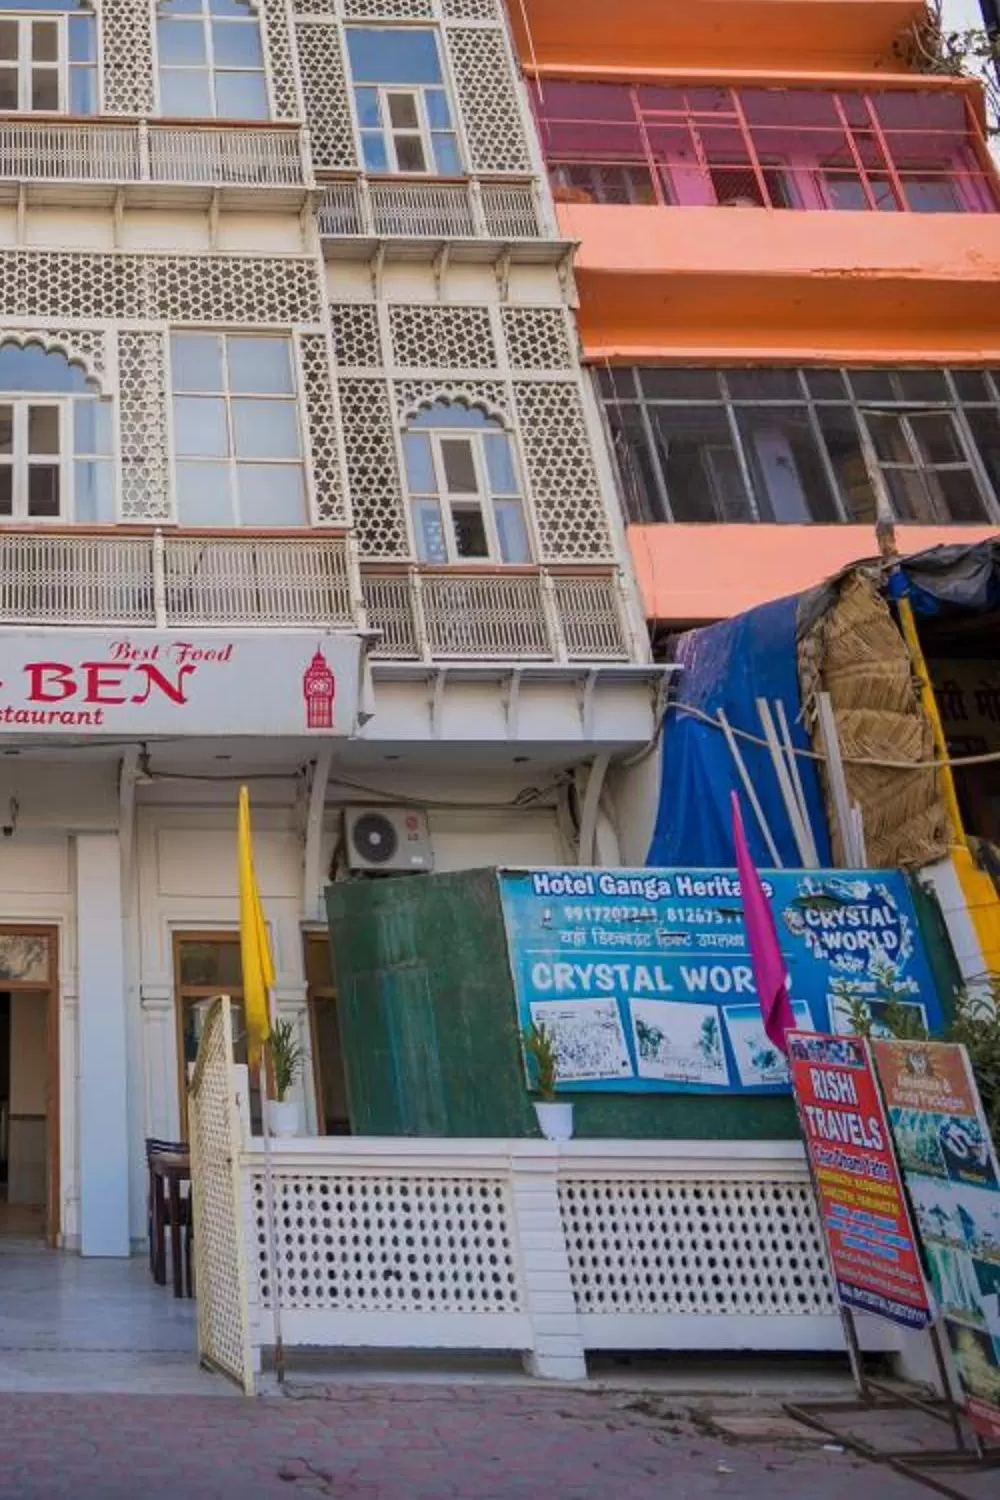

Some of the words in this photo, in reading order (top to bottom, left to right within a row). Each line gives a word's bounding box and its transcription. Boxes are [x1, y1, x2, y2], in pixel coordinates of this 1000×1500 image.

[109, 641, 159, 661] Best
[169, 641, 233, 663] Food
[23, 661, 197, 705] BEN
[532, 873, 594, 895] Hotel
[600, 874, 671, 899] Ganga
[677, 876, 773, 898] Heritae
[804, 905, 897, 928] CRYSTAL
[821, 928, 898, 950] WORLD
[531, 961, 674, 992] CRYSTAL
[680, 963, 793, 995] WOR
[810, 1067, 857, 1105] RISHI
[804, 1104, 884, 1151] TRAVELS
